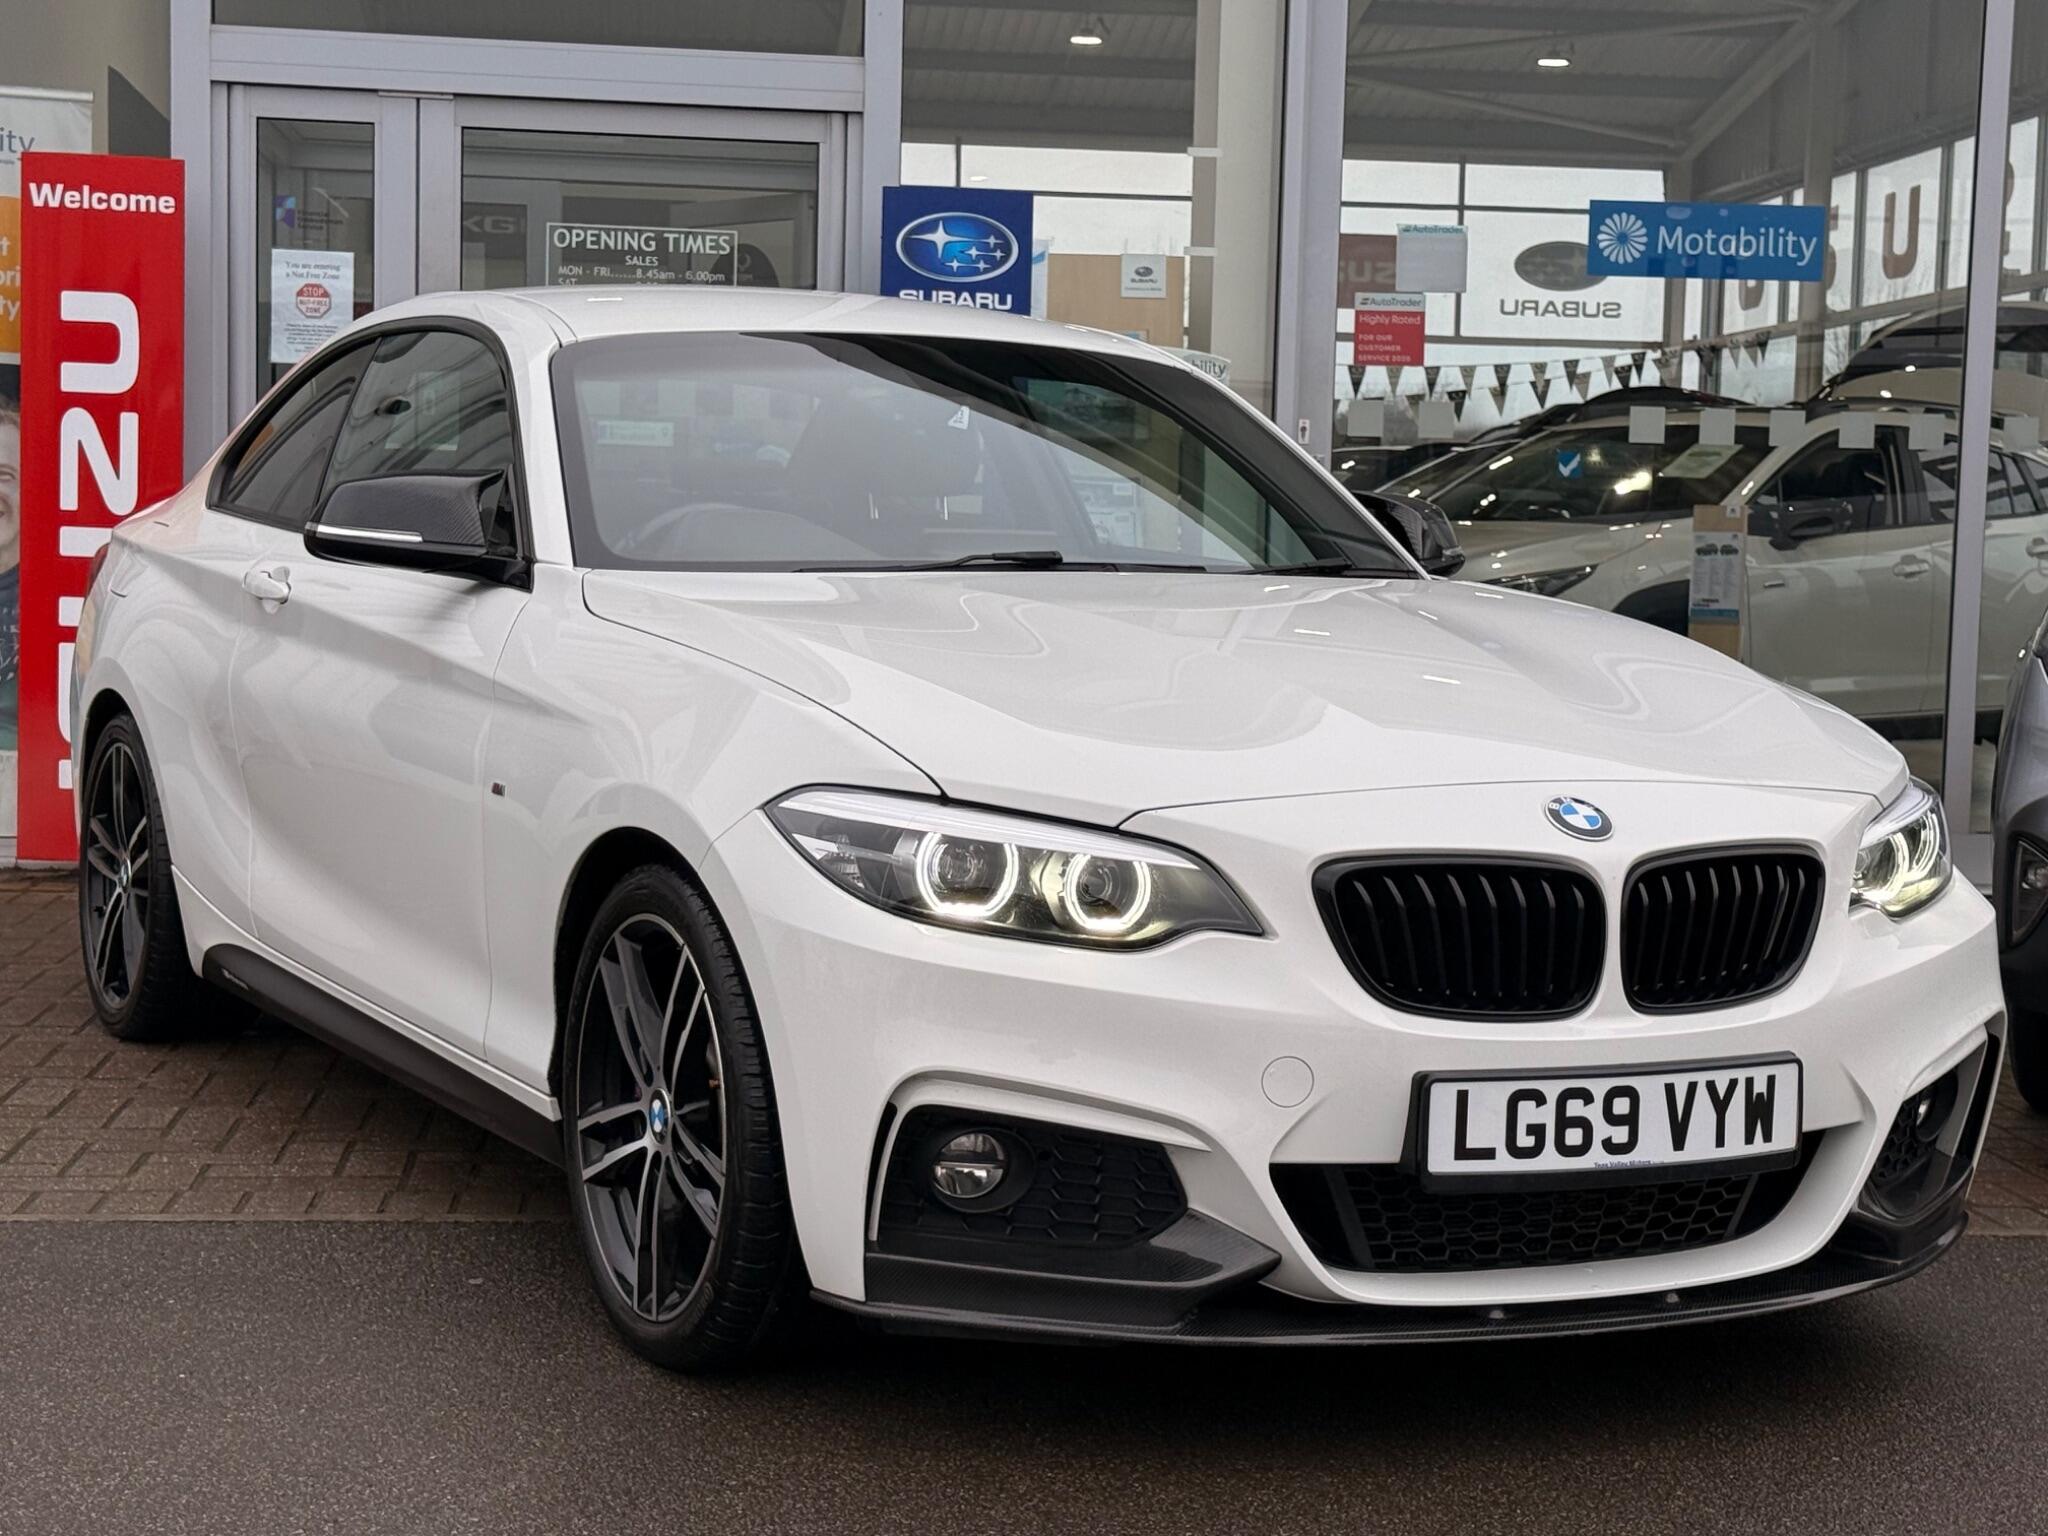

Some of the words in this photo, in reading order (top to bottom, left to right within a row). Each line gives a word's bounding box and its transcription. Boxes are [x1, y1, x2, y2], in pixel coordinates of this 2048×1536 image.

[29, 182, 176, 214] Welcome
[553, 228, 657, 252] OPENING
[664, 232, 731, 256] TIMES
[1657, 225, 1818, 267] Motability
[625, 255, 659, 267] SALES
[558, 265, 584, 277] MON
[685, 270, 726, 283] 6.00pm
[303, 287, 325, 297] STOP
[898, 289, 1012, 311] SUBARU
[1369, 297, 1421, 307] AutoTrader
[1359, 314, 1392, 326] Highly
[1392, 315, 1421, 325] Rated
[1358, 333, 1375, 341] FOR
[1375, 333, 1393, 341] OUR
[1358, 344, 1401, 352] CUSTOMER
[1358, 354, 1391, 362] SERVICE
[1453, 1085, 1641, 1161] LG69
[1663, 1074, 1776, 1152] VYW
